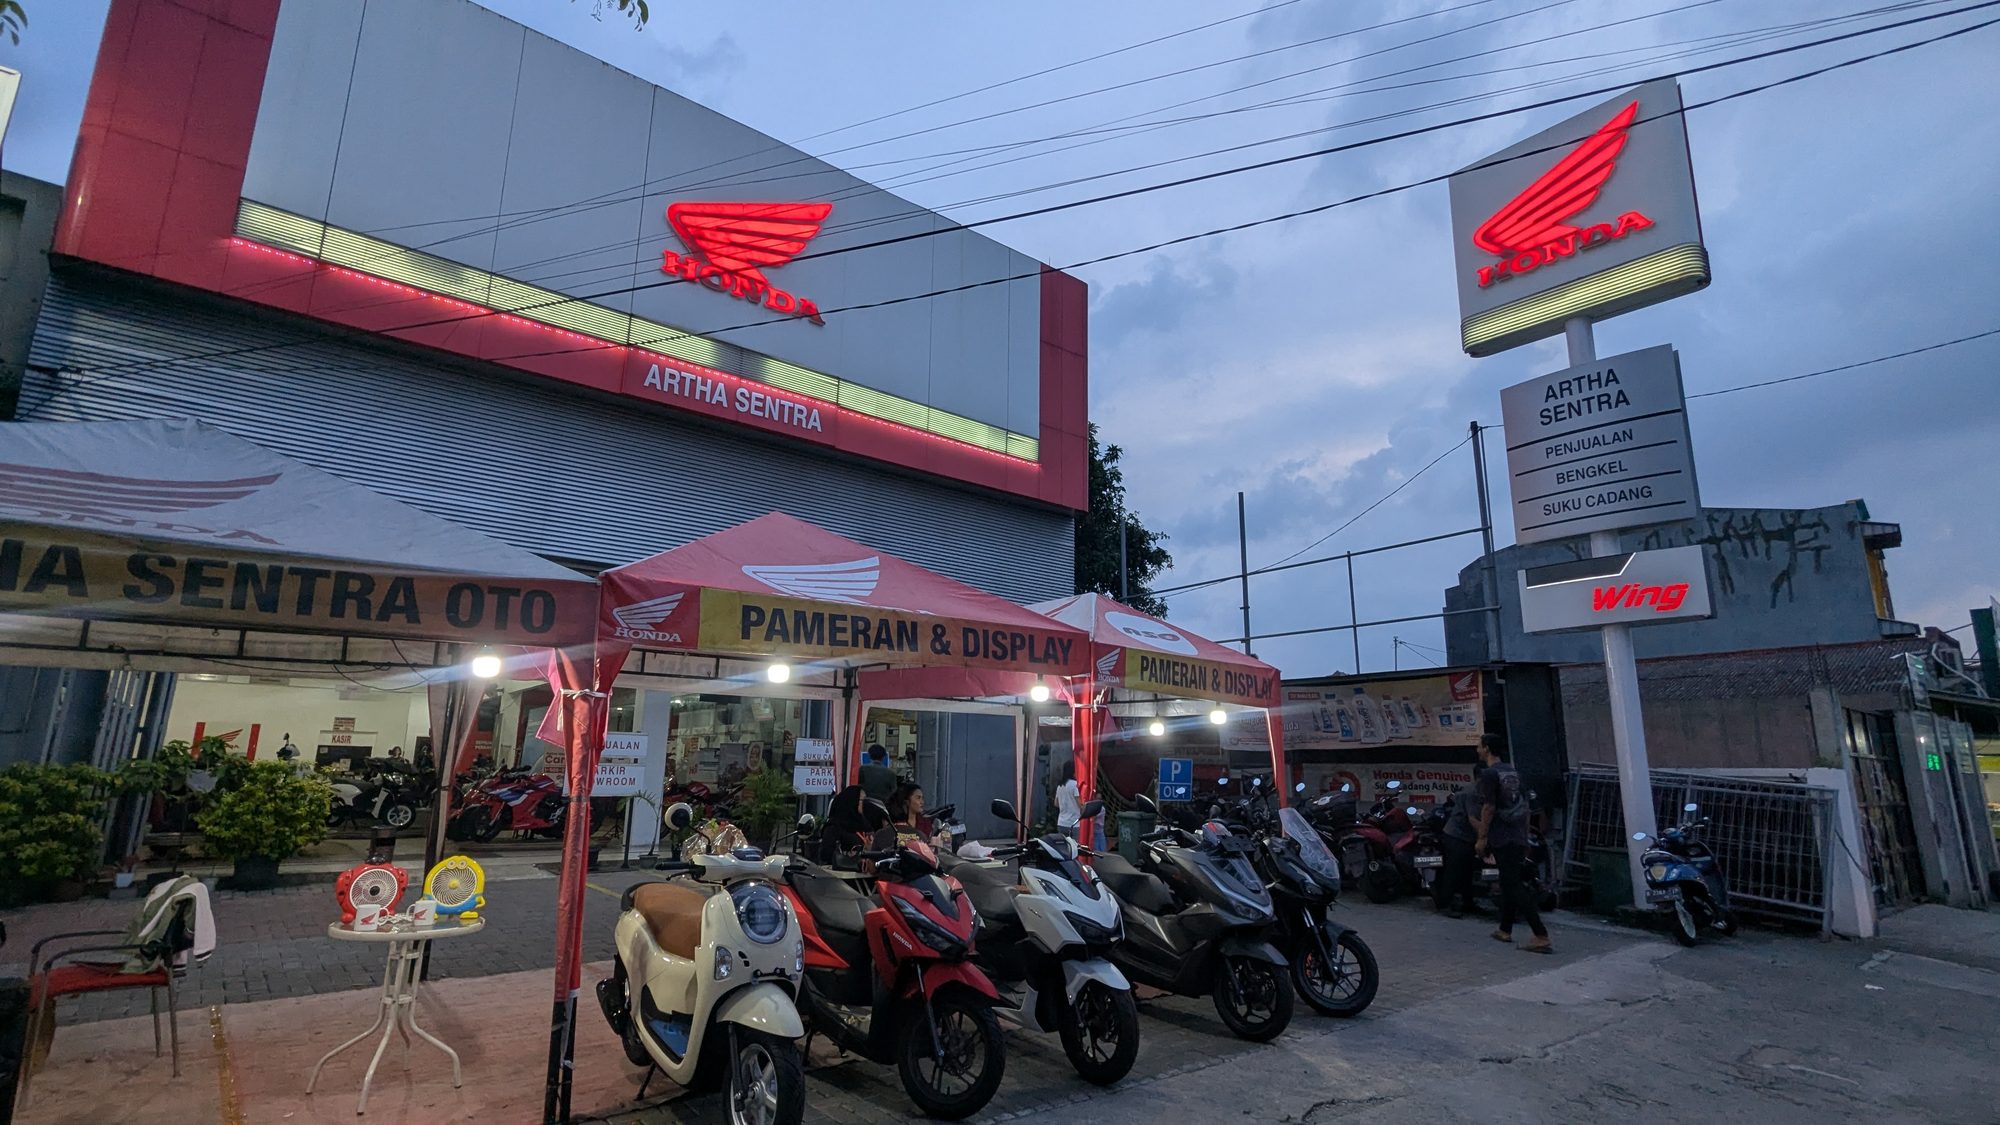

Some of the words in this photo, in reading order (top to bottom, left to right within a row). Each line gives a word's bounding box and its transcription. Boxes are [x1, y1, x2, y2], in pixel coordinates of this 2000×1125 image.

[1477, 211, 1656, 288] HONDA
[661, 249, 826, 327] HONDA
[643, 364, 729, 408] ARTHA
[735, 387, 822, 432] SENTRA
[1544, 368, 1620, 403] ARTHA
[1539, 389, 1631, 426] SENTRA
[1545, 428, 1634, 459] PENJUALAN
[1556, 460, 1628, 485] BENGKEL
[1543, 497, 1582, 516] SUKU
[1585, 485, 1653, 508] CADANG
[123, 553, 421, 625] SENTRA
[445, 582, 556, 634] OTO
[1592, 582, 1690, 612] Wing
[613, 627, 682, 643] HONDA
[741, 604, 919, 653] PAMERAN
[930, 623, 952, 656] &
[962, 627, 1074, 665] DISPLAY
[1097, 673, 1120, 683] HONDA
[1140, 655, 1207, 690] PAMERAN
[1212, 668, 1220, 692] &
[1224, 670, 1273, 699] DISPLAY
[332, 735, 352, 744] KASIR
[603, 740, 640, 750] UALAN
[596, 777, 636, 786] WROOM
[805, 778, 835, 786] BENGK
[810, 768, 833, 777] PARK
[1171, 761, 1182, 782] P
[1374, 770, 1412, 780] Honda
[1416, 770, 1471, 782] Genuine
[892, 931, 913, 951] HONDA
